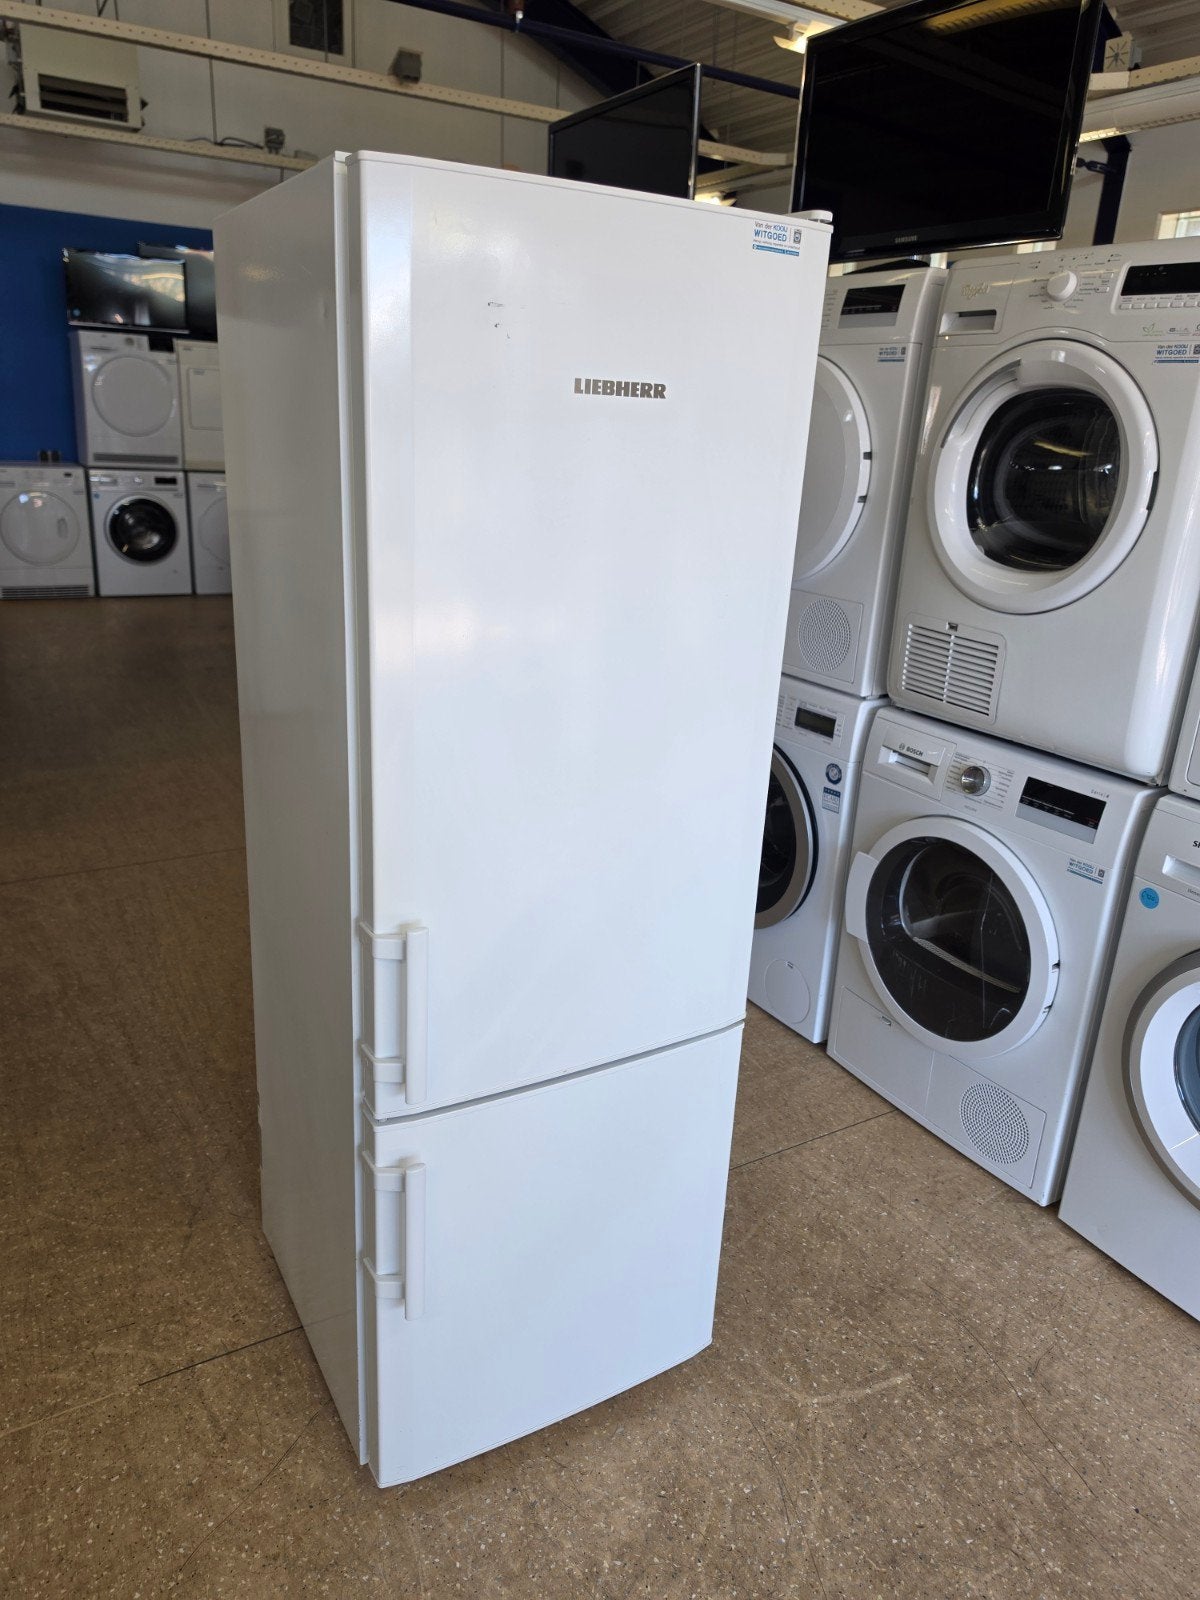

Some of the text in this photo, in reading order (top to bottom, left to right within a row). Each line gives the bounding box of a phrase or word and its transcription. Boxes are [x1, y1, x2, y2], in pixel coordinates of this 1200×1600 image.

[754, 229, 787, 242] WITGOED
[574, 378, 666, 398] LIEBHERR
[906, 746, 923, 756] BOSCH
